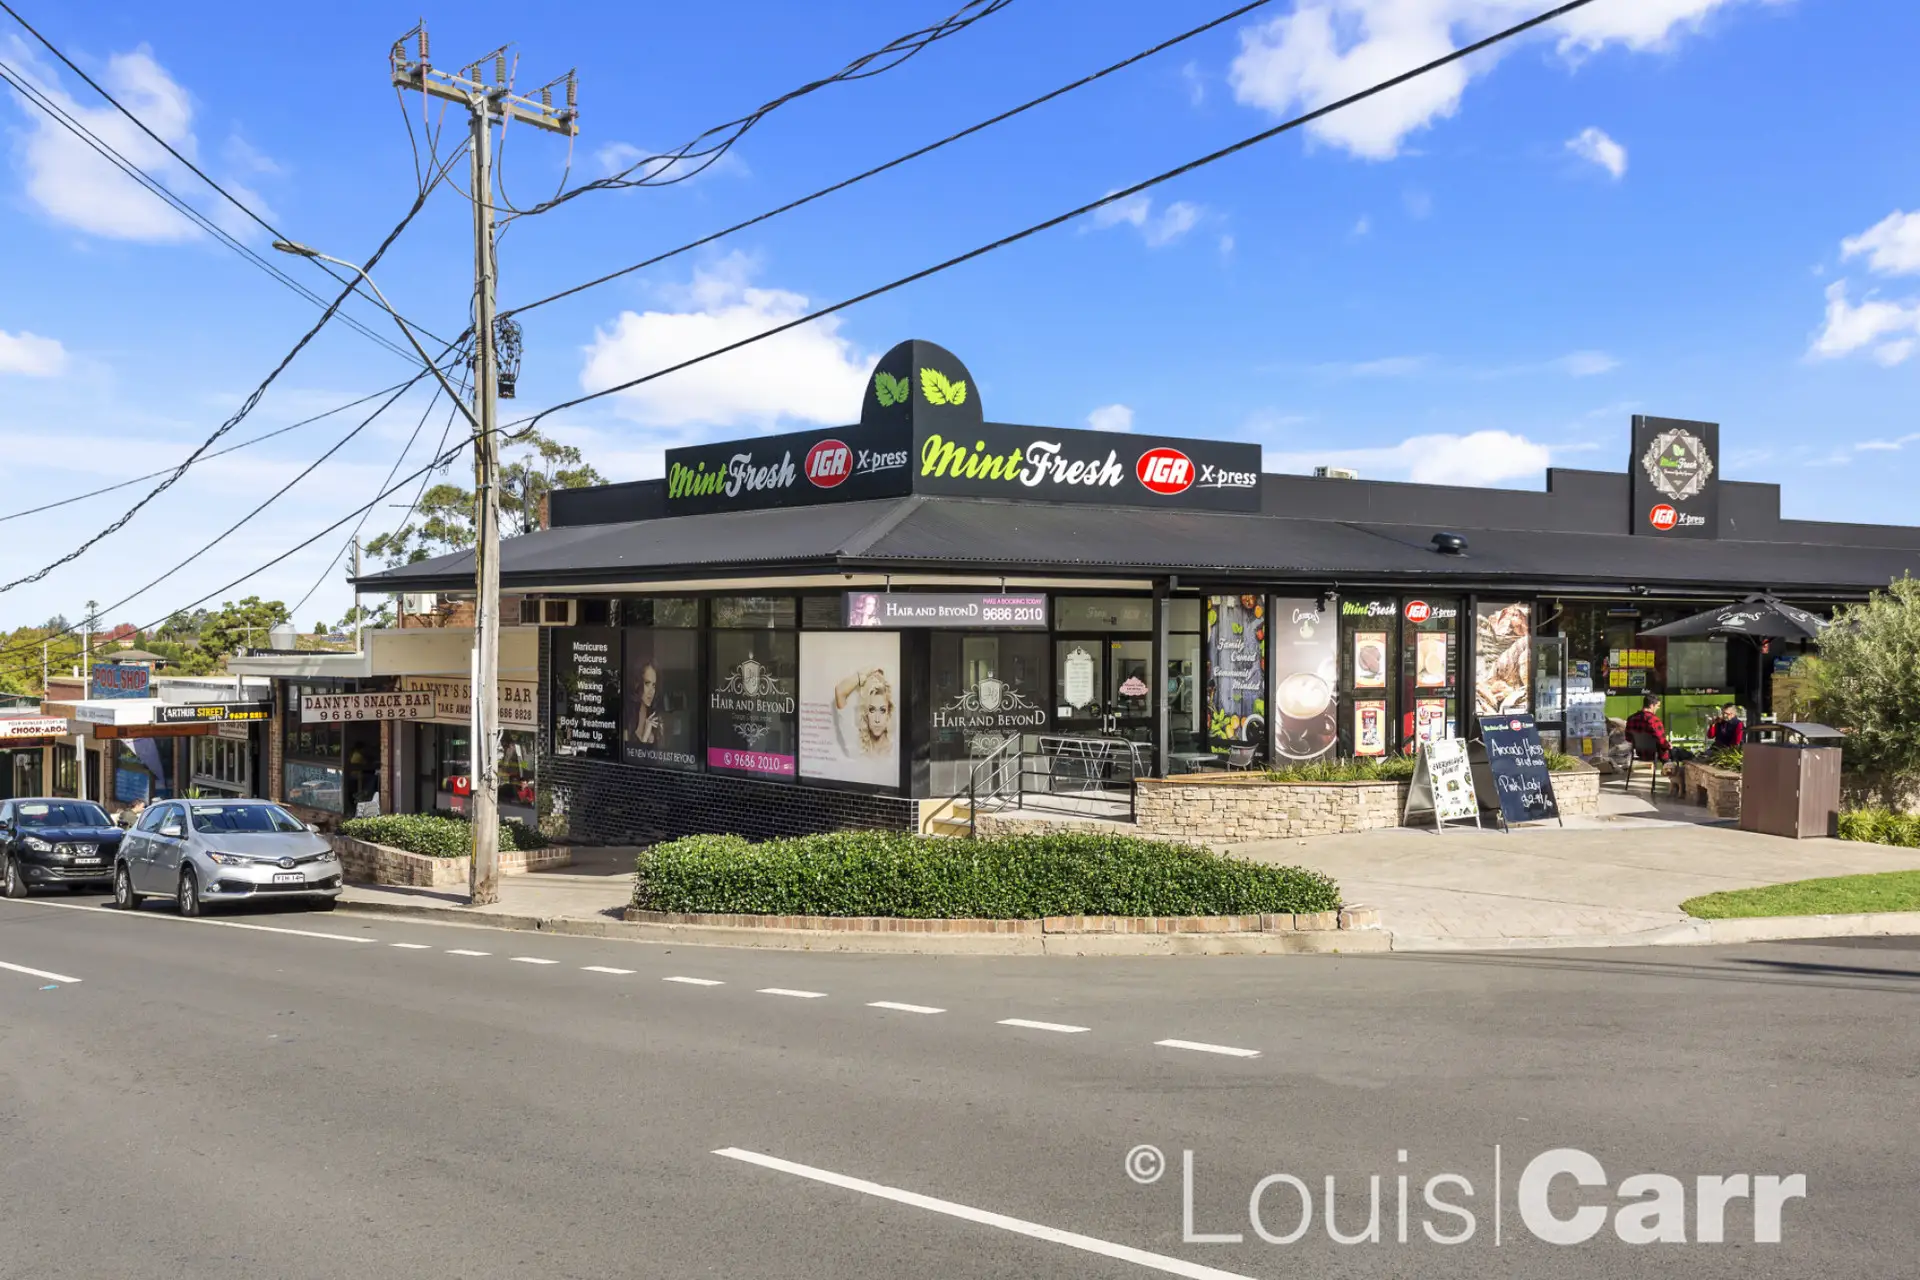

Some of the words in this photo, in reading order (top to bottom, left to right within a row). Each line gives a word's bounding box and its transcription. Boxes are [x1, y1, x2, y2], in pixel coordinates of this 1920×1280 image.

[810, 448, 848, 478] IGA
[856, 449, 908, 473] X-press
[1143, 457, 1189, 485] IGA
[1199, 464, 1257, 488] X-press
[1652, 508, 1675, 524] IGA
[914, 607, 936, 616] AND
[983, 608, 1011, 620] 9686
[1014, 608, 1042, 620] 2010
[1407, 605, 1427, 618] IGA
[573, 642, 608, 652] Manicures
[1217, 639, 1245, 652] Family
[573, 653, 607, 663] Pedicures
[578, 665, 602, 675] Facials
[1213, 666, 1251, 680] Community
[95, 667, 119, 688] POOL
[120, 669, 147, 690] SHOP
[577, 681, 603, 692] Waxing
[505, 687, 532, 702] BAR
[578, 692, 602, 703] Tinting
[305, 695, 360, 710] DANNY'S
[363, 695, 402, 708] SNACK
[405, 693, 431, 706] BAR
[711, 693, 734, 709] HAIR
[735, 700, 754, 711] AND
[756, 697, 795, 714] BEYOND
[320, 710, 364, 720] 9686
[375, 708, 417, 718] 8828
[438, 703, 453, 713] TAKE
[498, 708, 512, 718] 686
[514, 709, 532, 720] 8828
[574, 703, 605, 715] Massage
[560, 716, 579, 727] Body
[582, 718, 616, 729] Treatment
[933, 712, 966, 728] HAIR
[969, 715, 994, 726] AND
[998, 710, 1046, 726] BEYOND
[572, 730, 590, 739] Make
[592, 731, 603, 741] Up
[1491, 738, 1524, 756] Avocado
[734, 753, 755, 768] 9686
[757, 755, 780, 770] 2010
